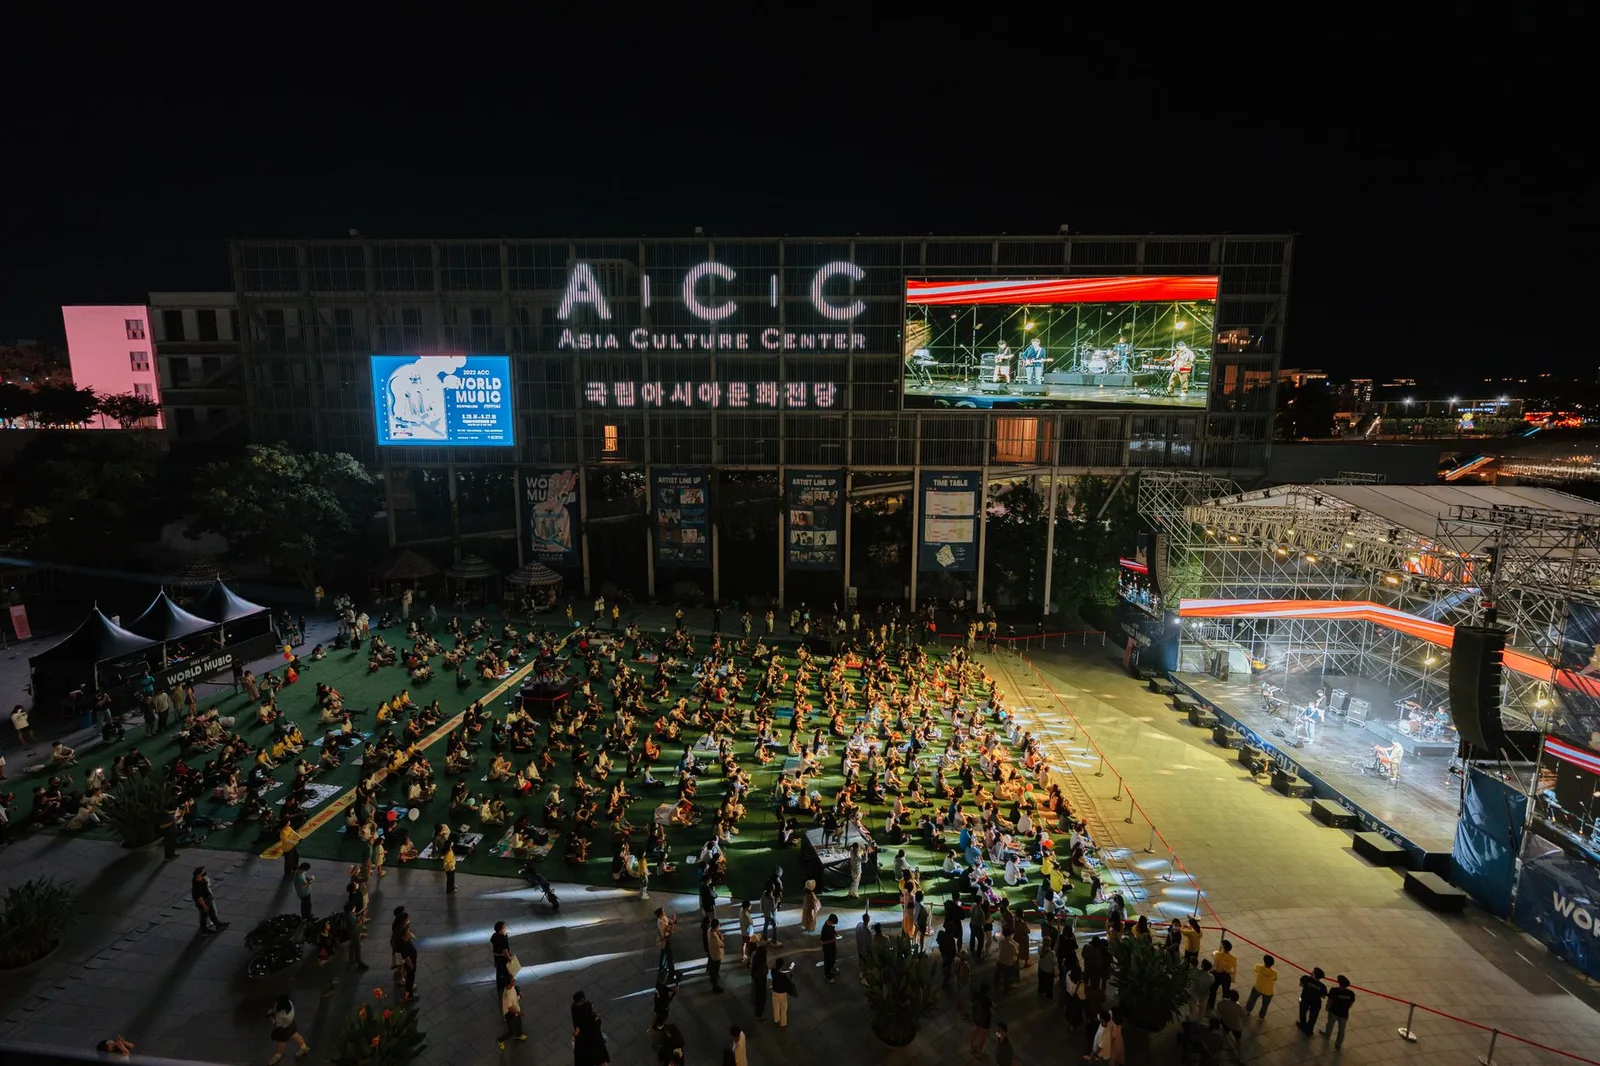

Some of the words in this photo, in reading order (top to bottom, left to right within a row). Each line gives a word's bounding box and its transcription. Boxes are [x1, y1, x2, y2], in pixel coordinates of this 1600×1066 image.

[456, 390, 501, 403] MUSIC
[584, 381, 837, 408] 국립아시아문화전당
[167, 665, 202, 685] WORLD
[204, 654, 233, 672] MUSIC
